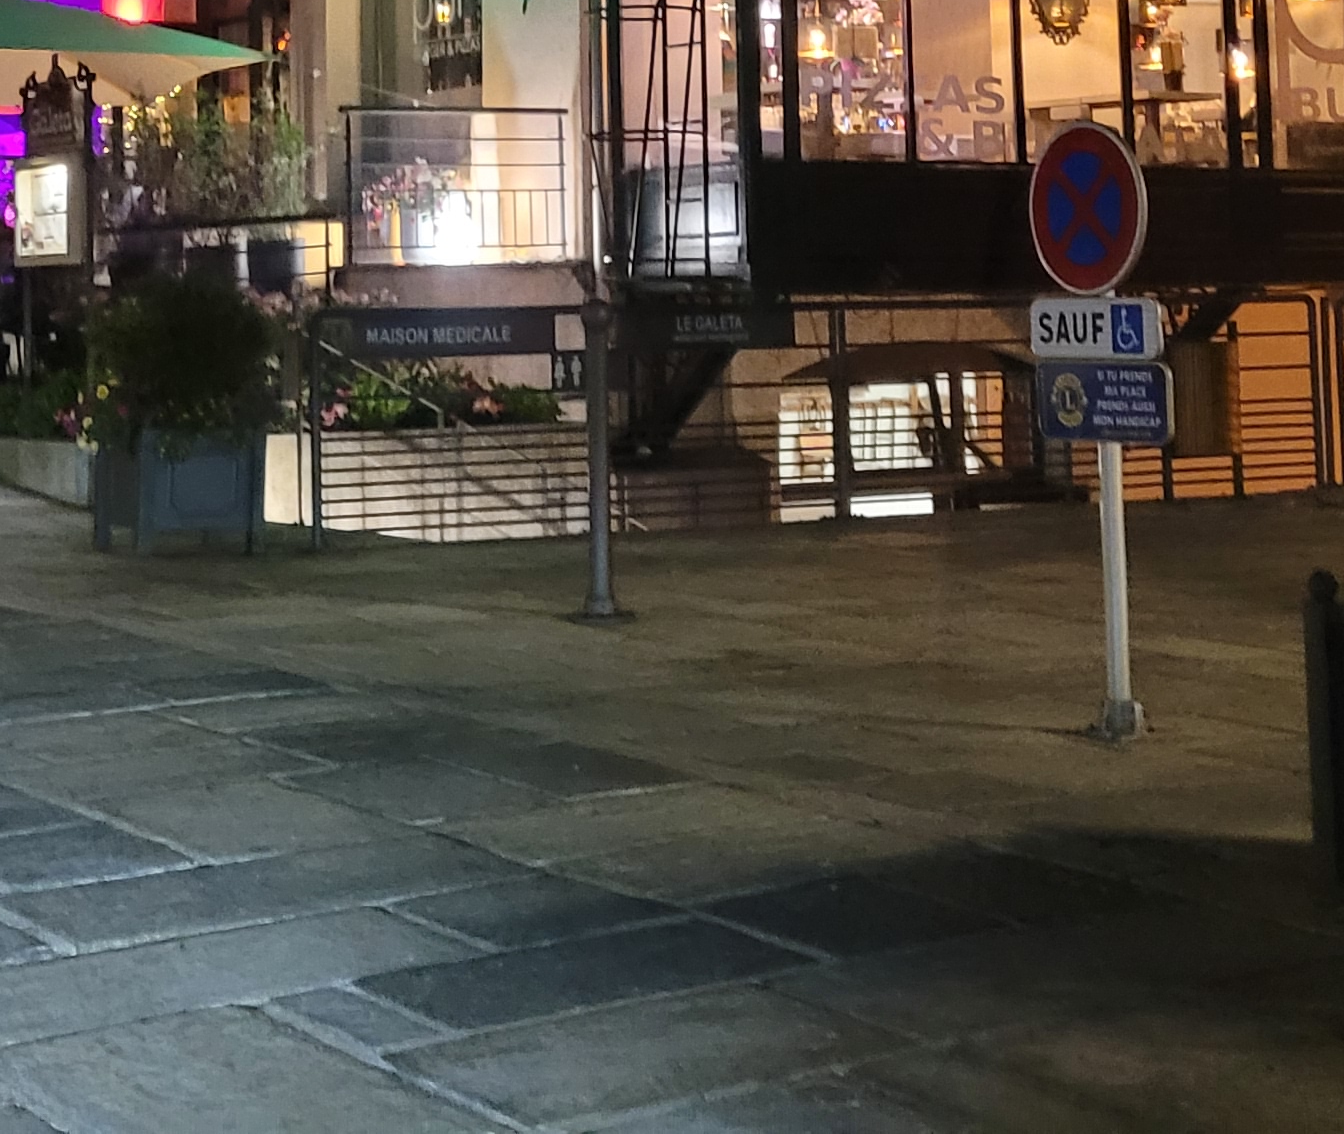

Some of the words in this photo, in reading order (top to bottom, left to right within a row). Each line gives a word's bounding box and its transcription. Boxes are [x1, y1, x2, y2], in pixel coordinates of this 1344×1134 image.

[799, 67, 1007, 116] PIZAS
[917, 117, 955, 158] &
[365, 326, 429, 345] MAISON
[432, 324, 512, 345] MEDICALE
[676, 314, 692, 332] LE
[695, 312, 743, 332] GALETA
[1038, 312, 1105, 344] SAUF
